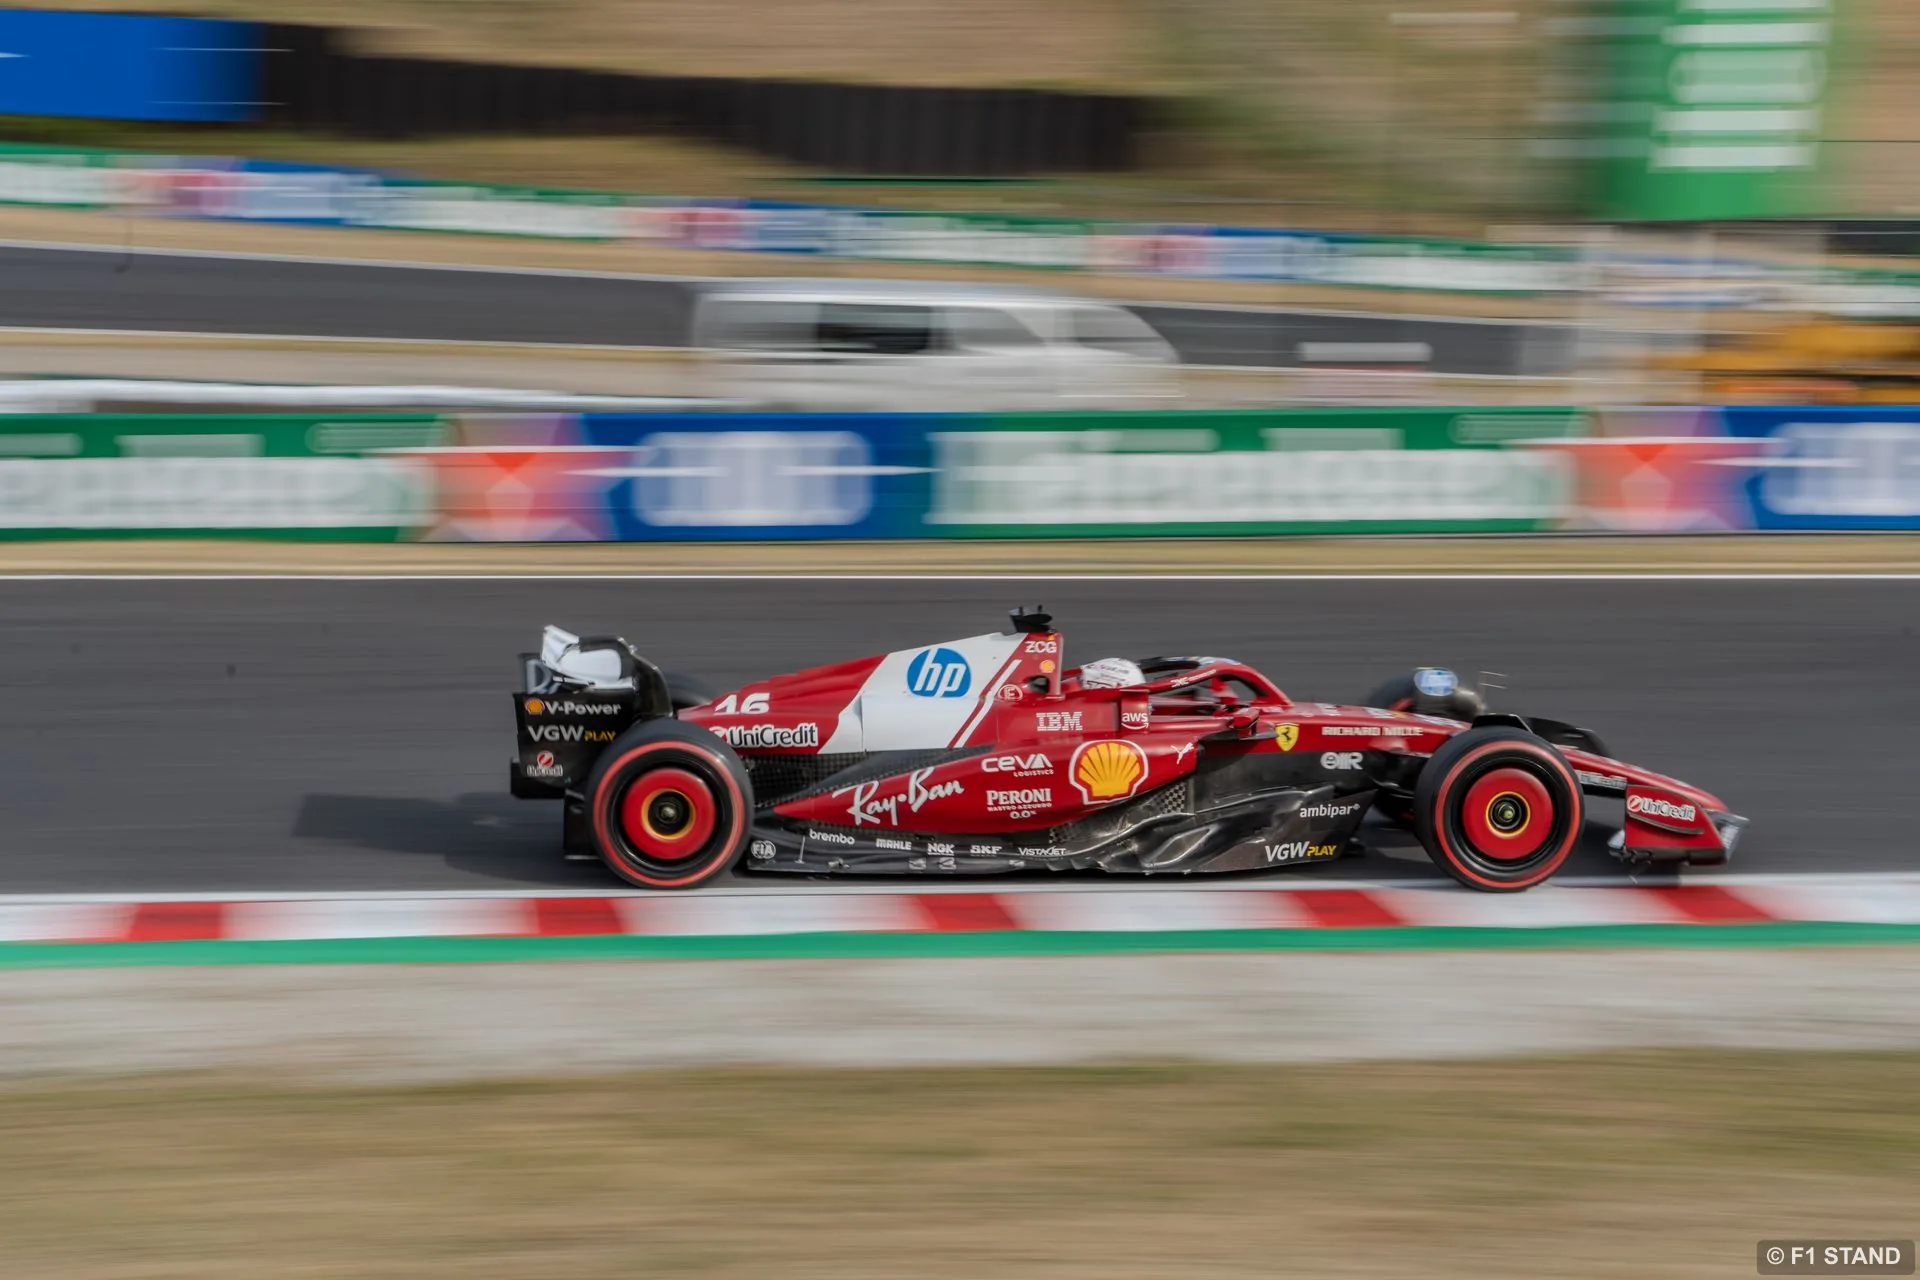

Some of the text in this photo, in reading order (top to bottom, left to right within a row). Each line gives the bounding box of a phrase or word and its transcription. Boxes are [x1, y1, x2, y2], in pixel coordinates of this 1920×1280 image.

[1025, 641, 1057, 653] ZCG
[912, 648, 967, 698] hp
[545, 700, 621, 715] V-Power
[713, 692, 770, 716] 16
[1036, 711, 1083, 732] IBM
[1122, 712, 1148, 723] aws
[527, 725, 616, 742] VGW PLAY
[728, 723, 818, 747] UniCredit
[986, 787, 1052, 806] PERONI
[1299, 803, 1352, 818] ambipar
[1640, 797, 1696, 822] UniCredit
[809, 828, 855, 845] brembo
[876, 838, 912, 850] MAHLE
[752, 842, 775, 858] FIA
[927, 843, 955, 855] NGK
[970, 844, 1002, 855] SKF
[1264, 841, 1337, 862] VGW PLAY
